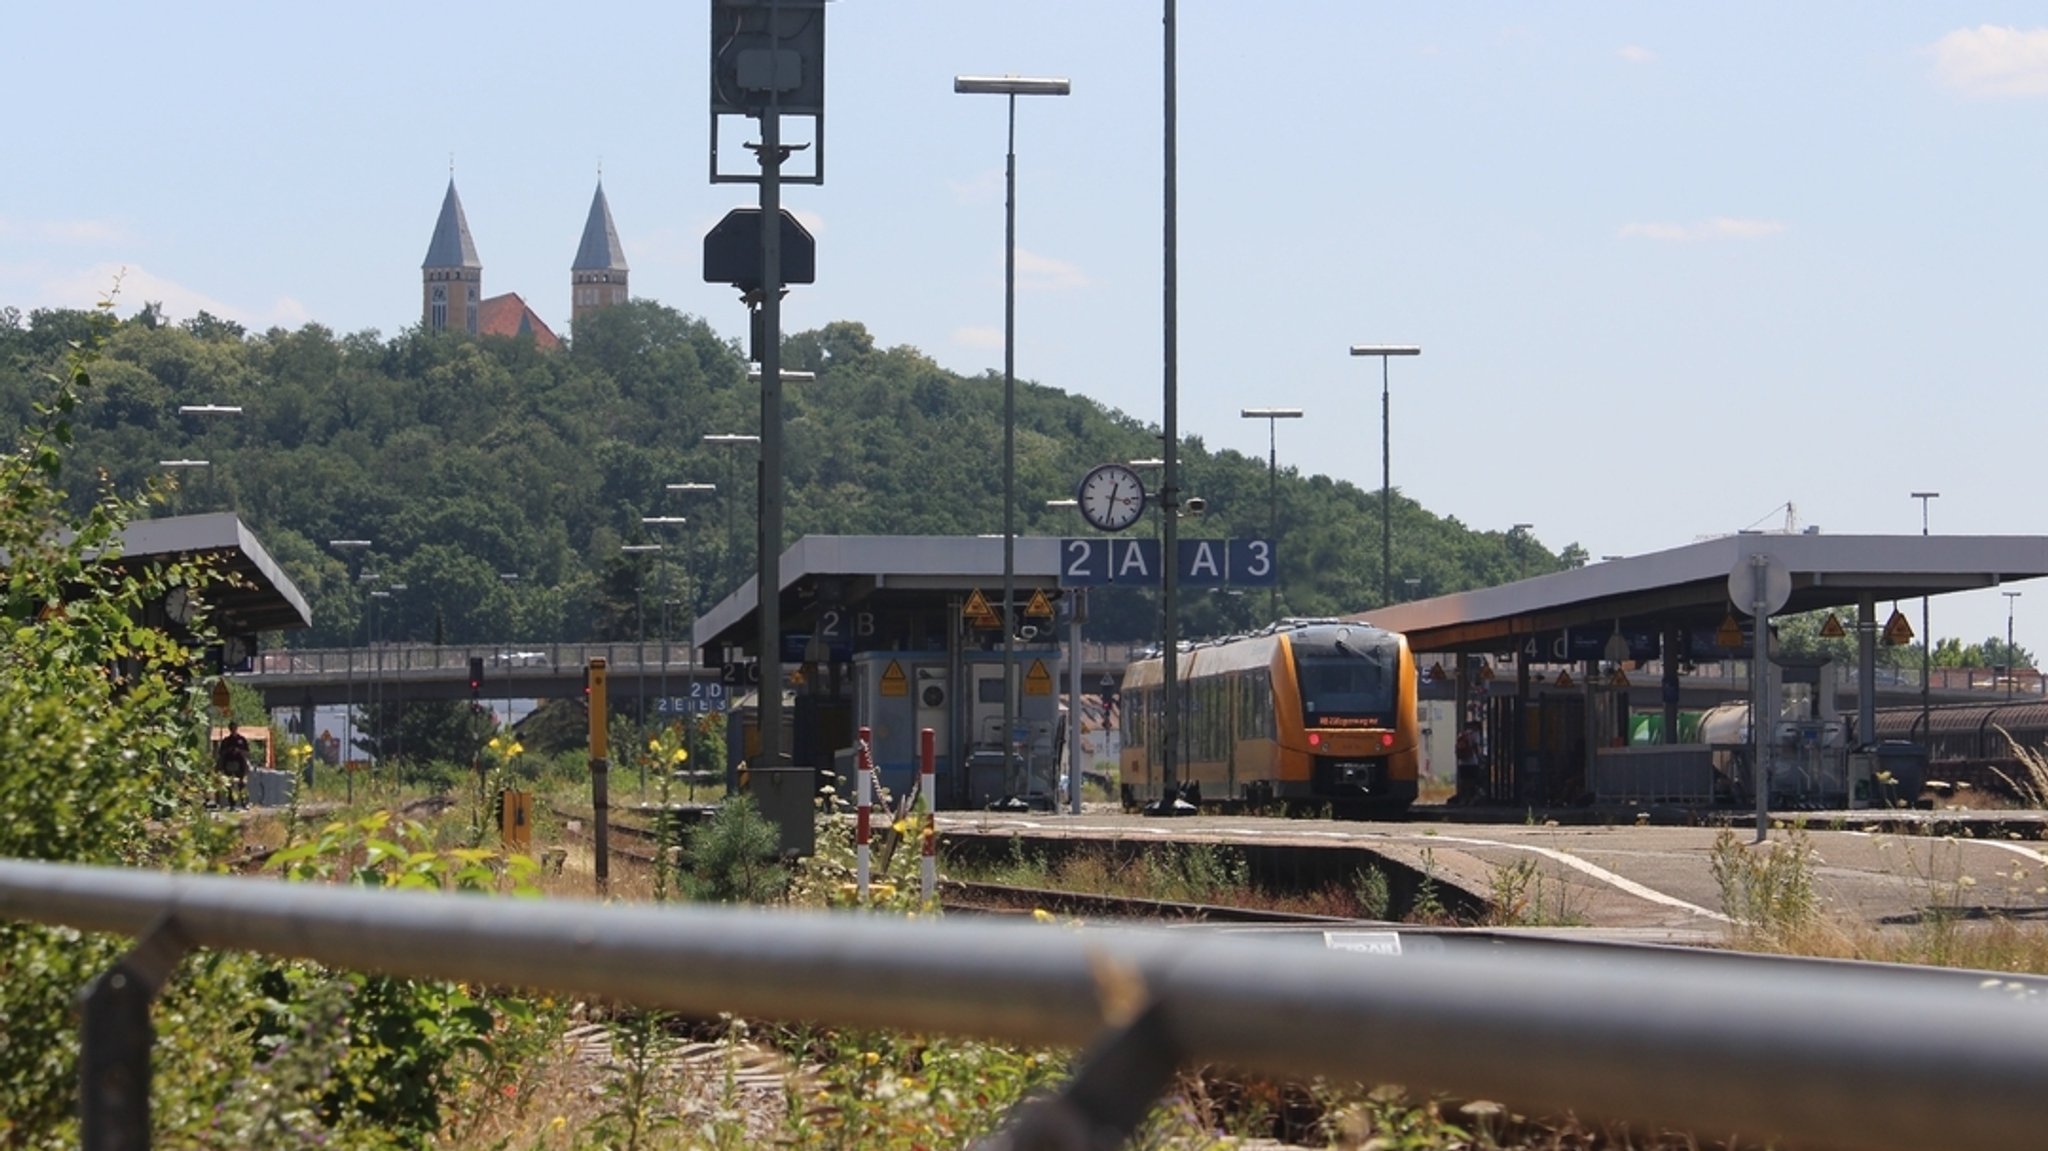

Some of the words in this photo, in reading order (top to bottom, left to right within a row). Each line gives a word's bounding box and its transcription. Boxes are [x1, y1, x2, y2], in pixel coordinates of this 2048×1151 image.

[1068, 540, 1091, 576] 2
[1119, 541, 1148, 576] A
[1190, 541, 1219, 576] A
[1247, 540, 1270, 576] 3
[822, 611, 839, 636] 2
[857, 612, 875, 636] B
[1524, 637, 1539, 658] 4
[723, 664, 735, 682] 2
[691, 683, 701, 697] 2
[711, 683, 721, 697] D
